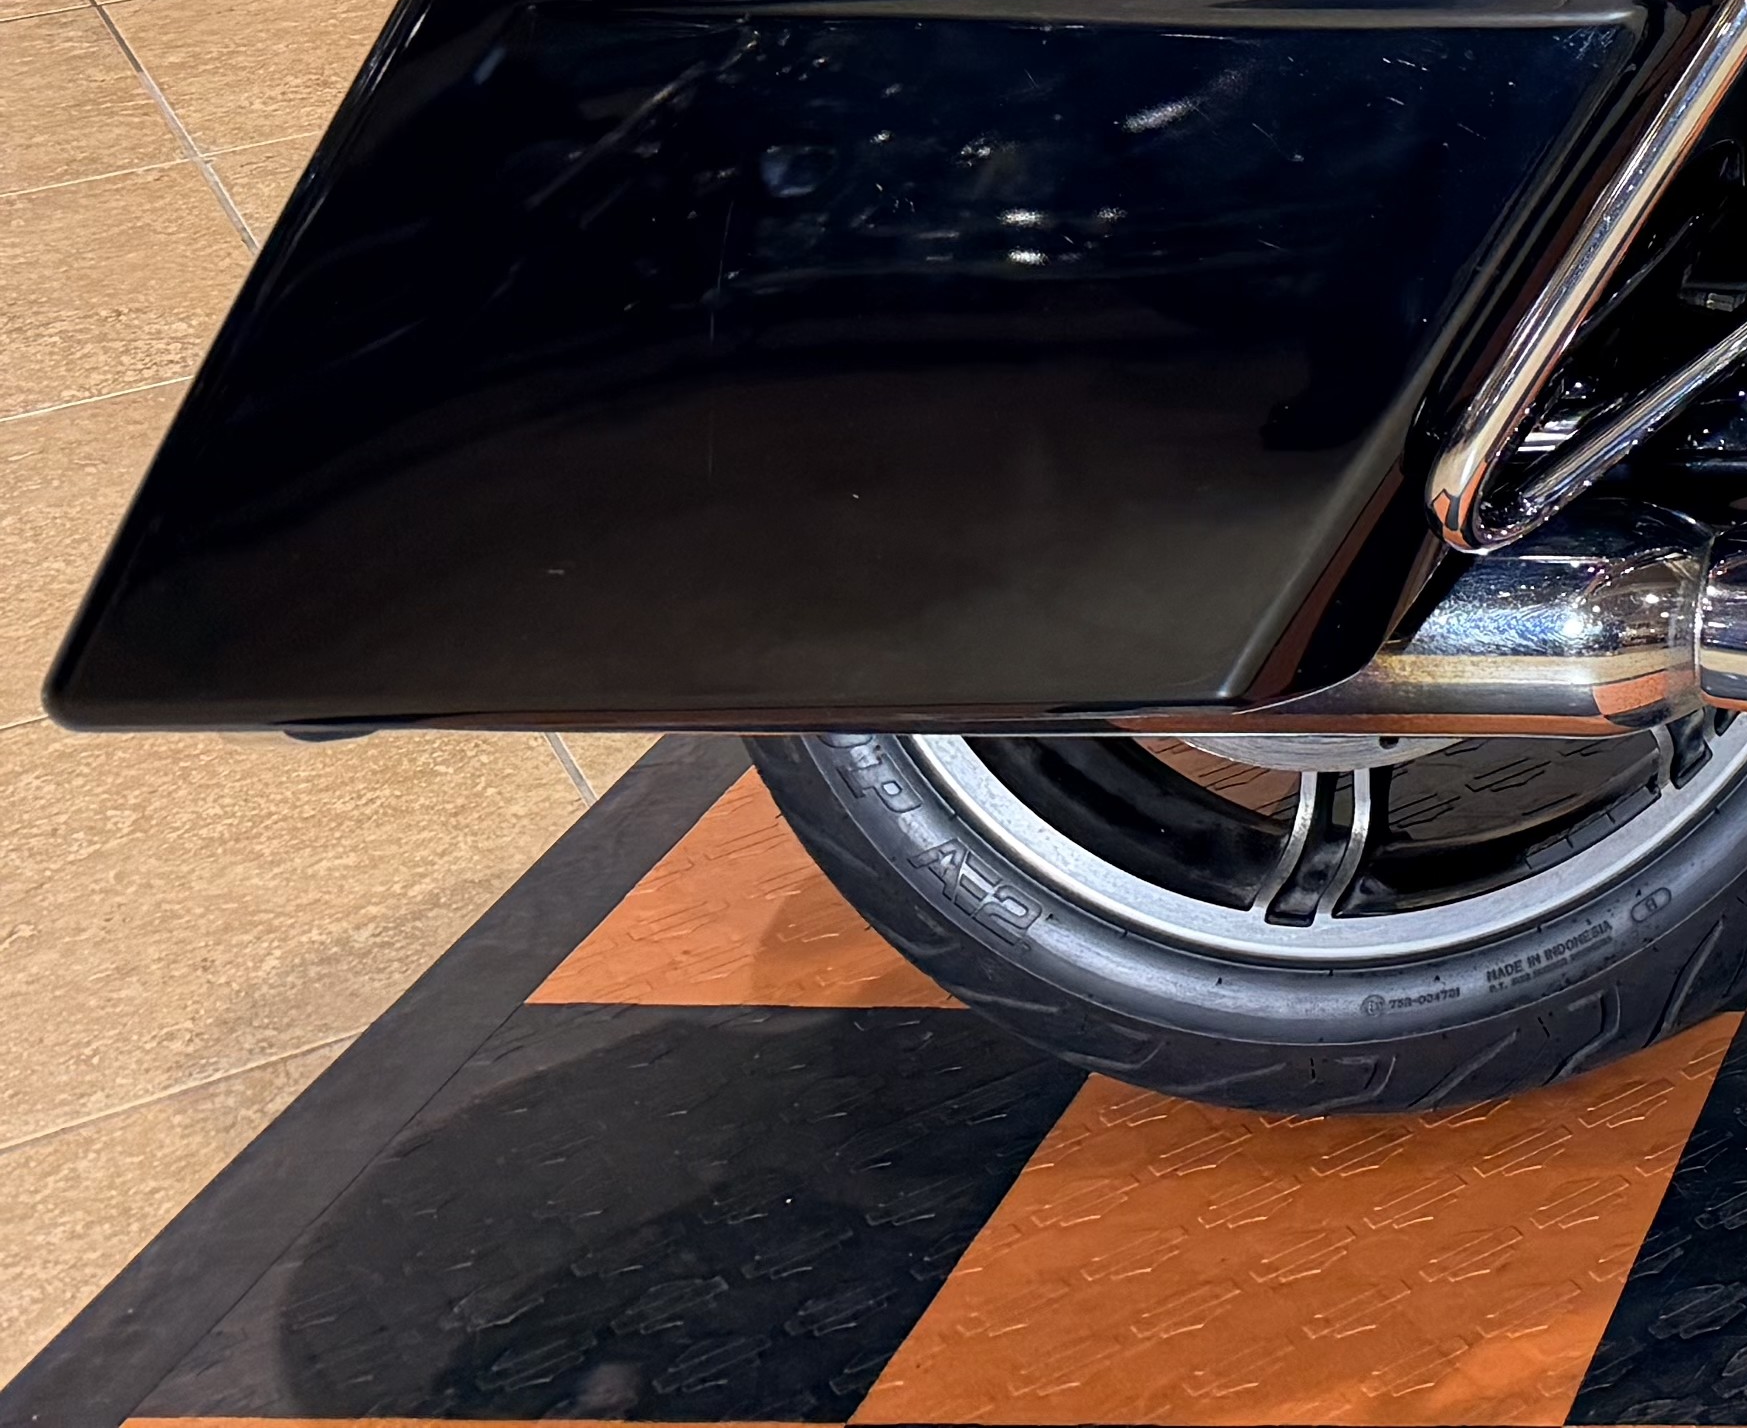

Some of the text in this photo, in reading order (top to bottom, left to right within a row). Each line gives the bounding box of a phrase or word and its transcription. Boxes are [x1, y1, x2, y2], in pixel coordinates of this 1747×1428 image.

[1486, 959, 1523, 983] MADE
[1527, 952, 1542, 969] IN
[1544, 920, 1614, 961] INDONESIA
